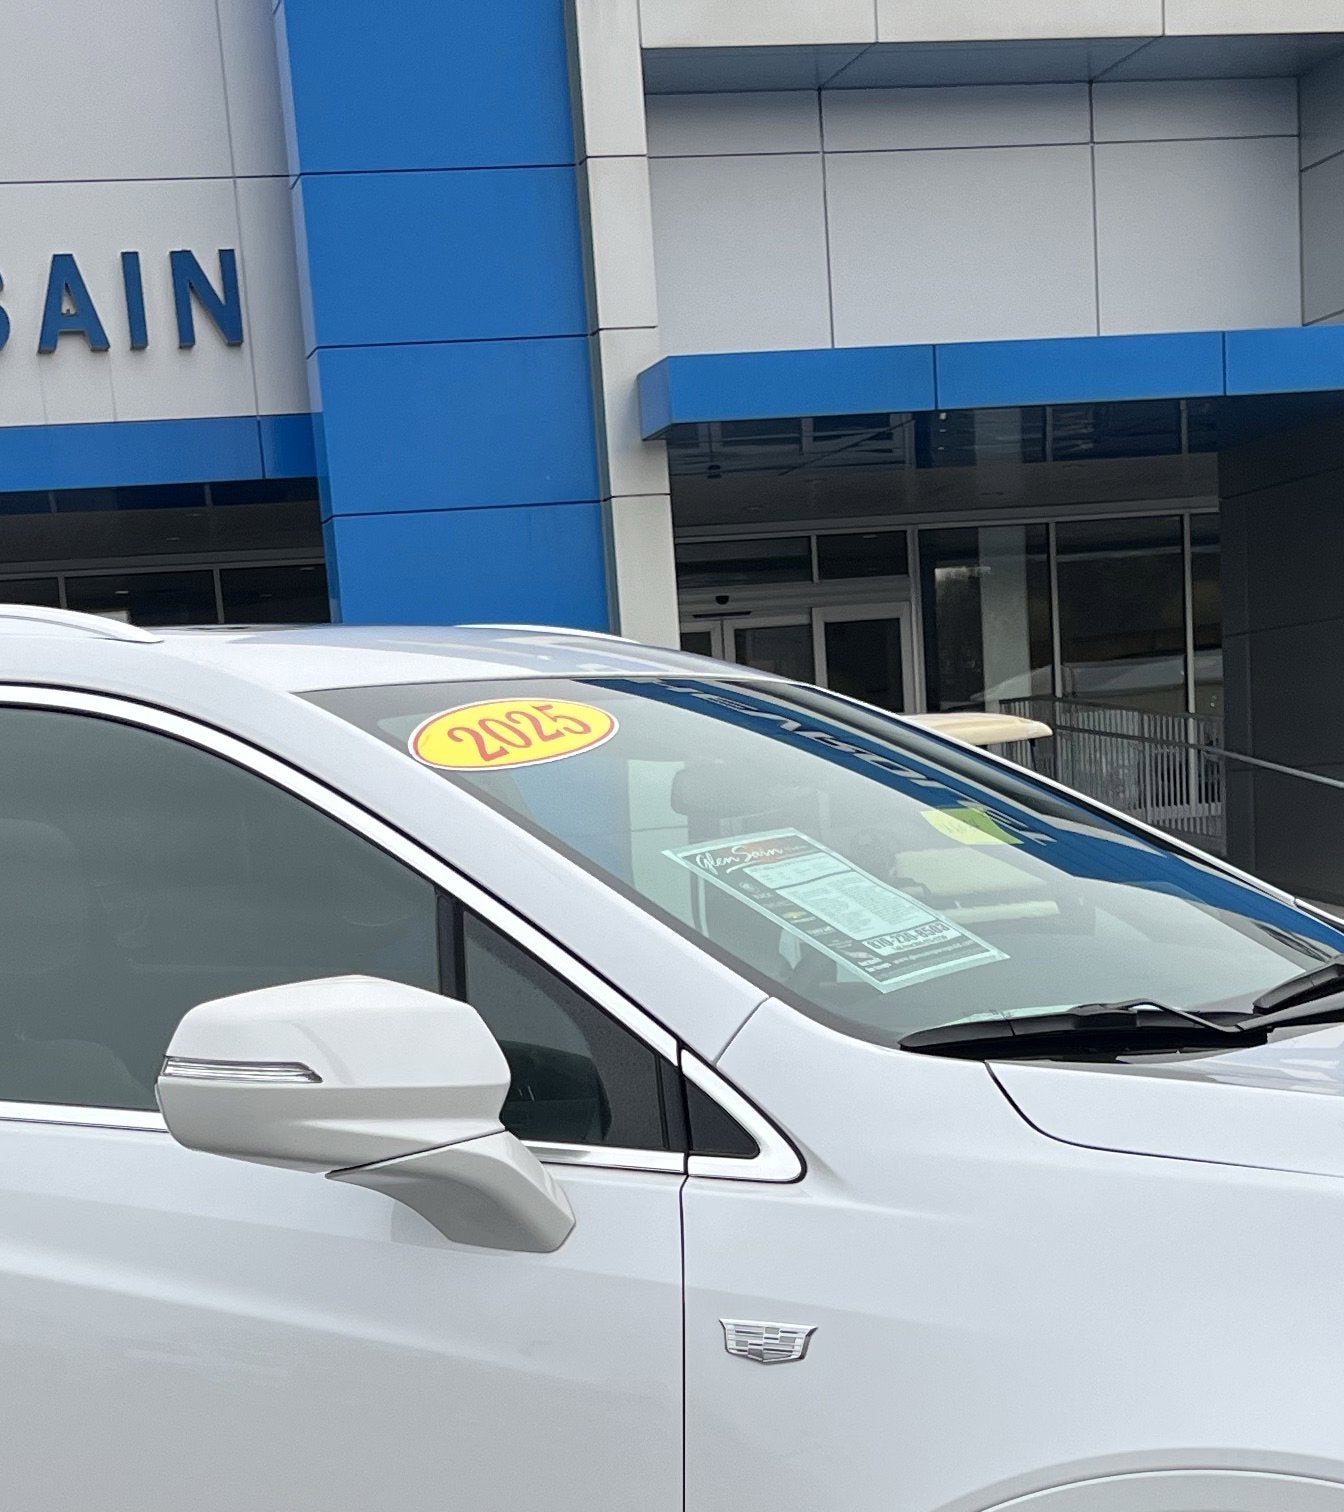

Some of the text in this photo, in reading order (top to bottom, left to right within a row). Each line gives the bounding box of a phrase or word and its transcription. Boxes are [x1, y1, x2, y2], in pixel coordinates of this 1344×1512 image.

[447, 704, 592, 761] 2025
[696, 852, 741, 875] Glen
[731, 845, 784, 864] Sain
